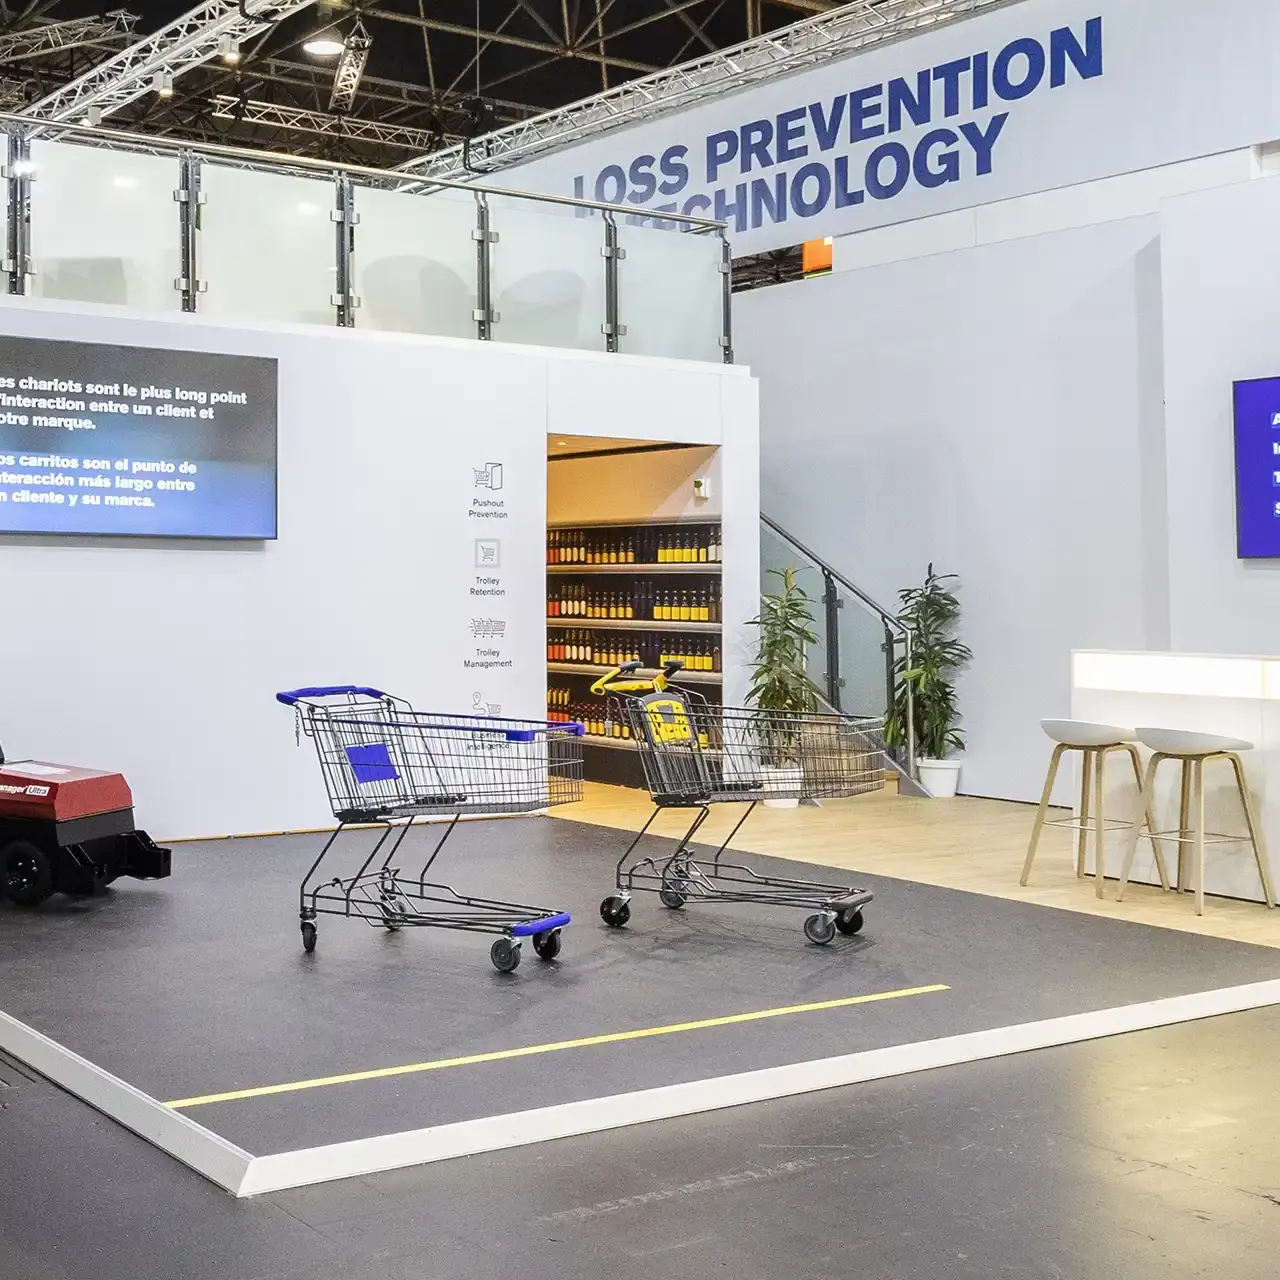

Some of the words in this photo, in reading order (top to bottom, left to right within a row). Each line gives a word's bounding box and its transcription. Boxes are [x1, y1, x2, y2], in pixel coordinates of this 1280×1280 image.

[574, 145, 689, 218] LOSS
[706, 15, 1104, 184] PREVENTION
[623, 112, 1010, 233] CHNOLOGY
[19, 376, 82, 393] chariots
[85, 383, 120, 396] sont
[123, 384, 138, 396] le
[140, 386, 172, 400] plus
[175, 388, 207, 404] long
[210, 391, 247, 404] point
[89, 400, 129, 414] entre
[132, 404, 152, 415] un
[155, 404, 196, 418] client
[199, 407, 215, 419] et
[32, 415, 96, 430] marque.
[19, 455, 79, 468] carritos
[82, 459, 110, 470] son
[114, 459, 128, 470] el
[132, 460, 175, 474] punto
[179, 461, 197, 474] de
[78, 474, 111, 488] más
[115, 476, 153, 491] largo
[157, 479, 195, 491] entre
[12, 490, 65, 504] cliente
[69, 494, 78, 506] y
[82, 495, 100, 505] su
[104, 495, 155, 507] marca.
[473, 498, 504, 507] Pushout
[468, 509, 508, 518] Prevention
[476, 576, 500, 586] Trolley
[469, 587, 505, 596] Retention
[476, 649, 500, 658] Trolley
[464, 660, 513, 669] Management
